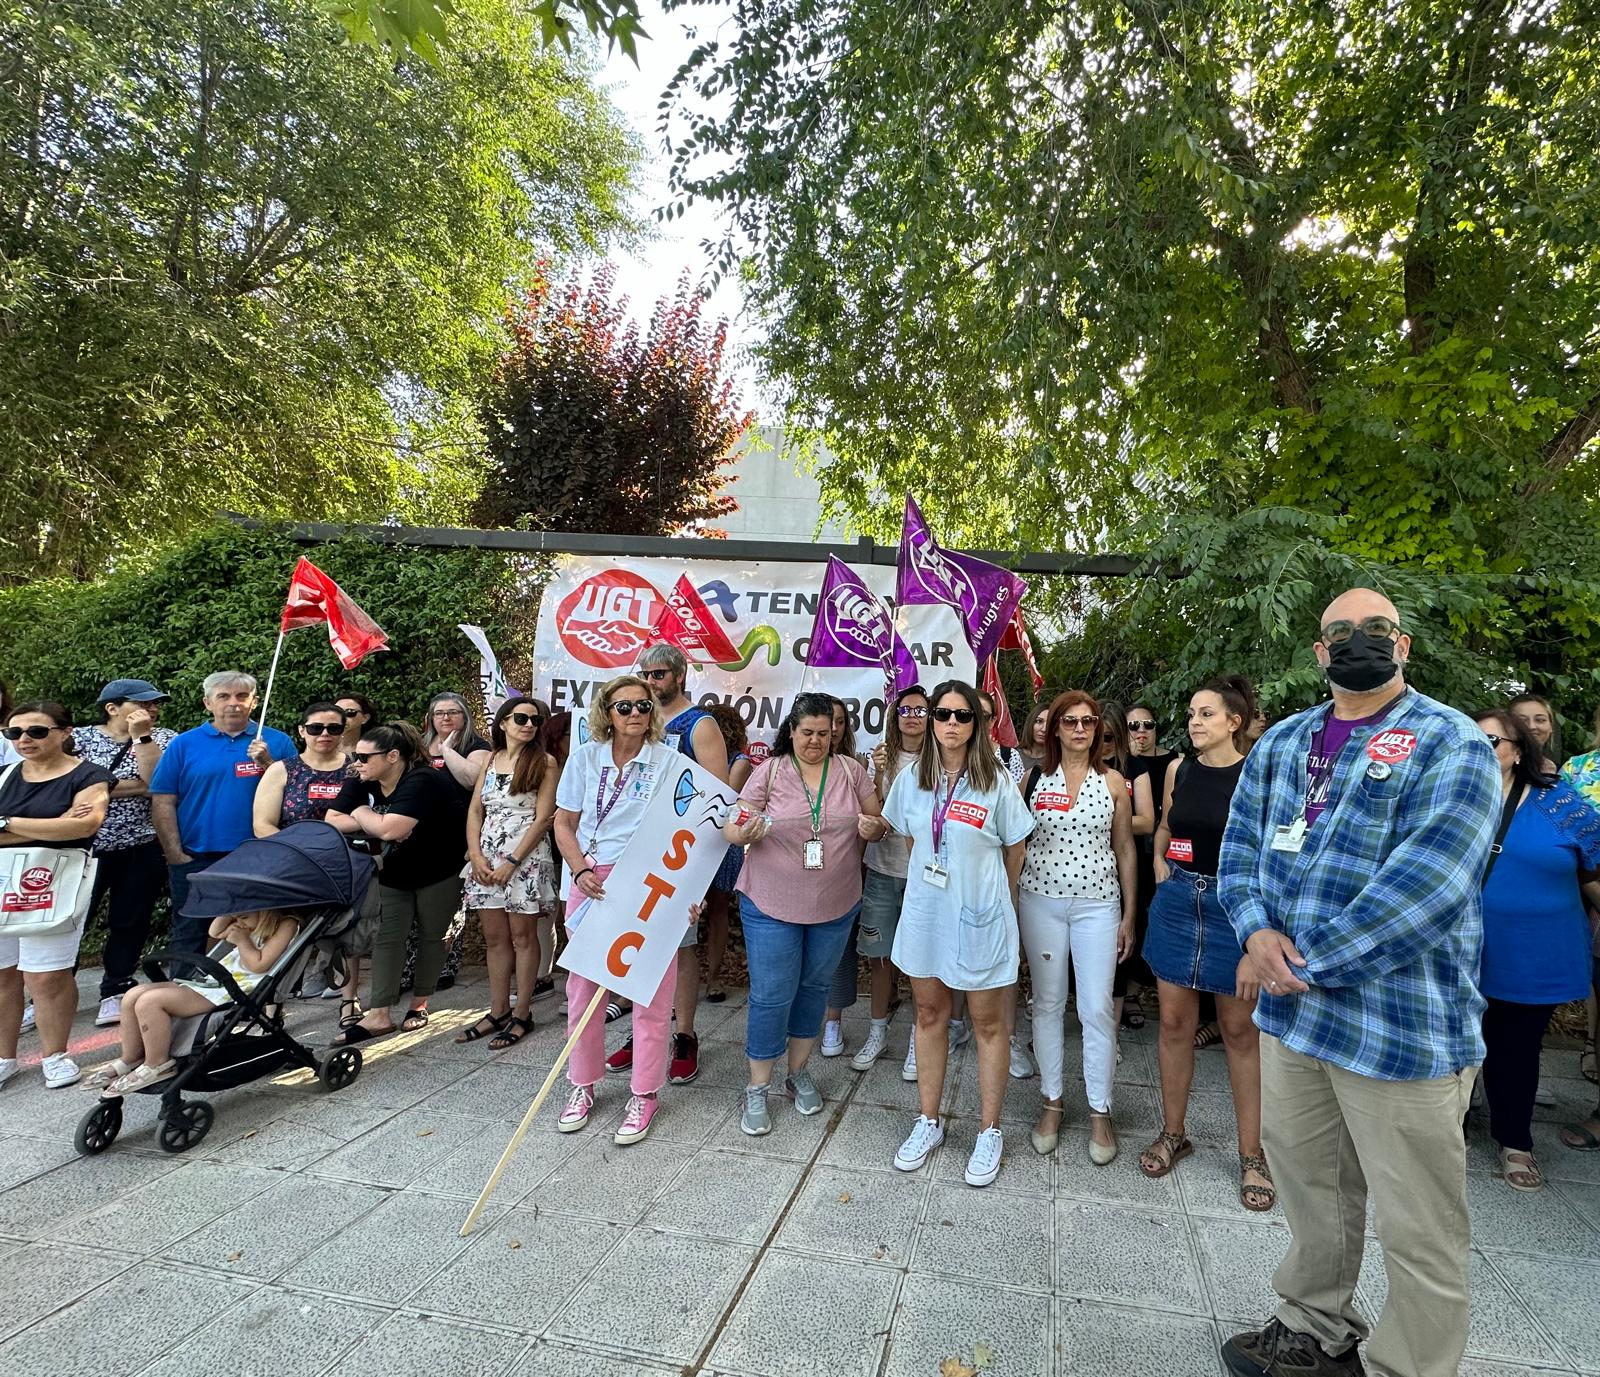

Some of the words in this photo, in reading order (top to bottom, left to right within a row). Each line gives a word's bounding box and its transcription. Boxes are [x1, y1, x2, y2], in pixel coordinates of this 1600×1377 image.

[580, 584, 657, 629] UGT
[834, 588, 889, 640] UGT
[1377, 732, 1415, 747] UGT
[750, 745, 769, 757] UGT
[1037, 795, 1070, 804] CCOO
[951, 803, 987, 820] CCOO
[1170, 841, 1192, 852] CCOO
[27, 869, 51, 880] UGT
